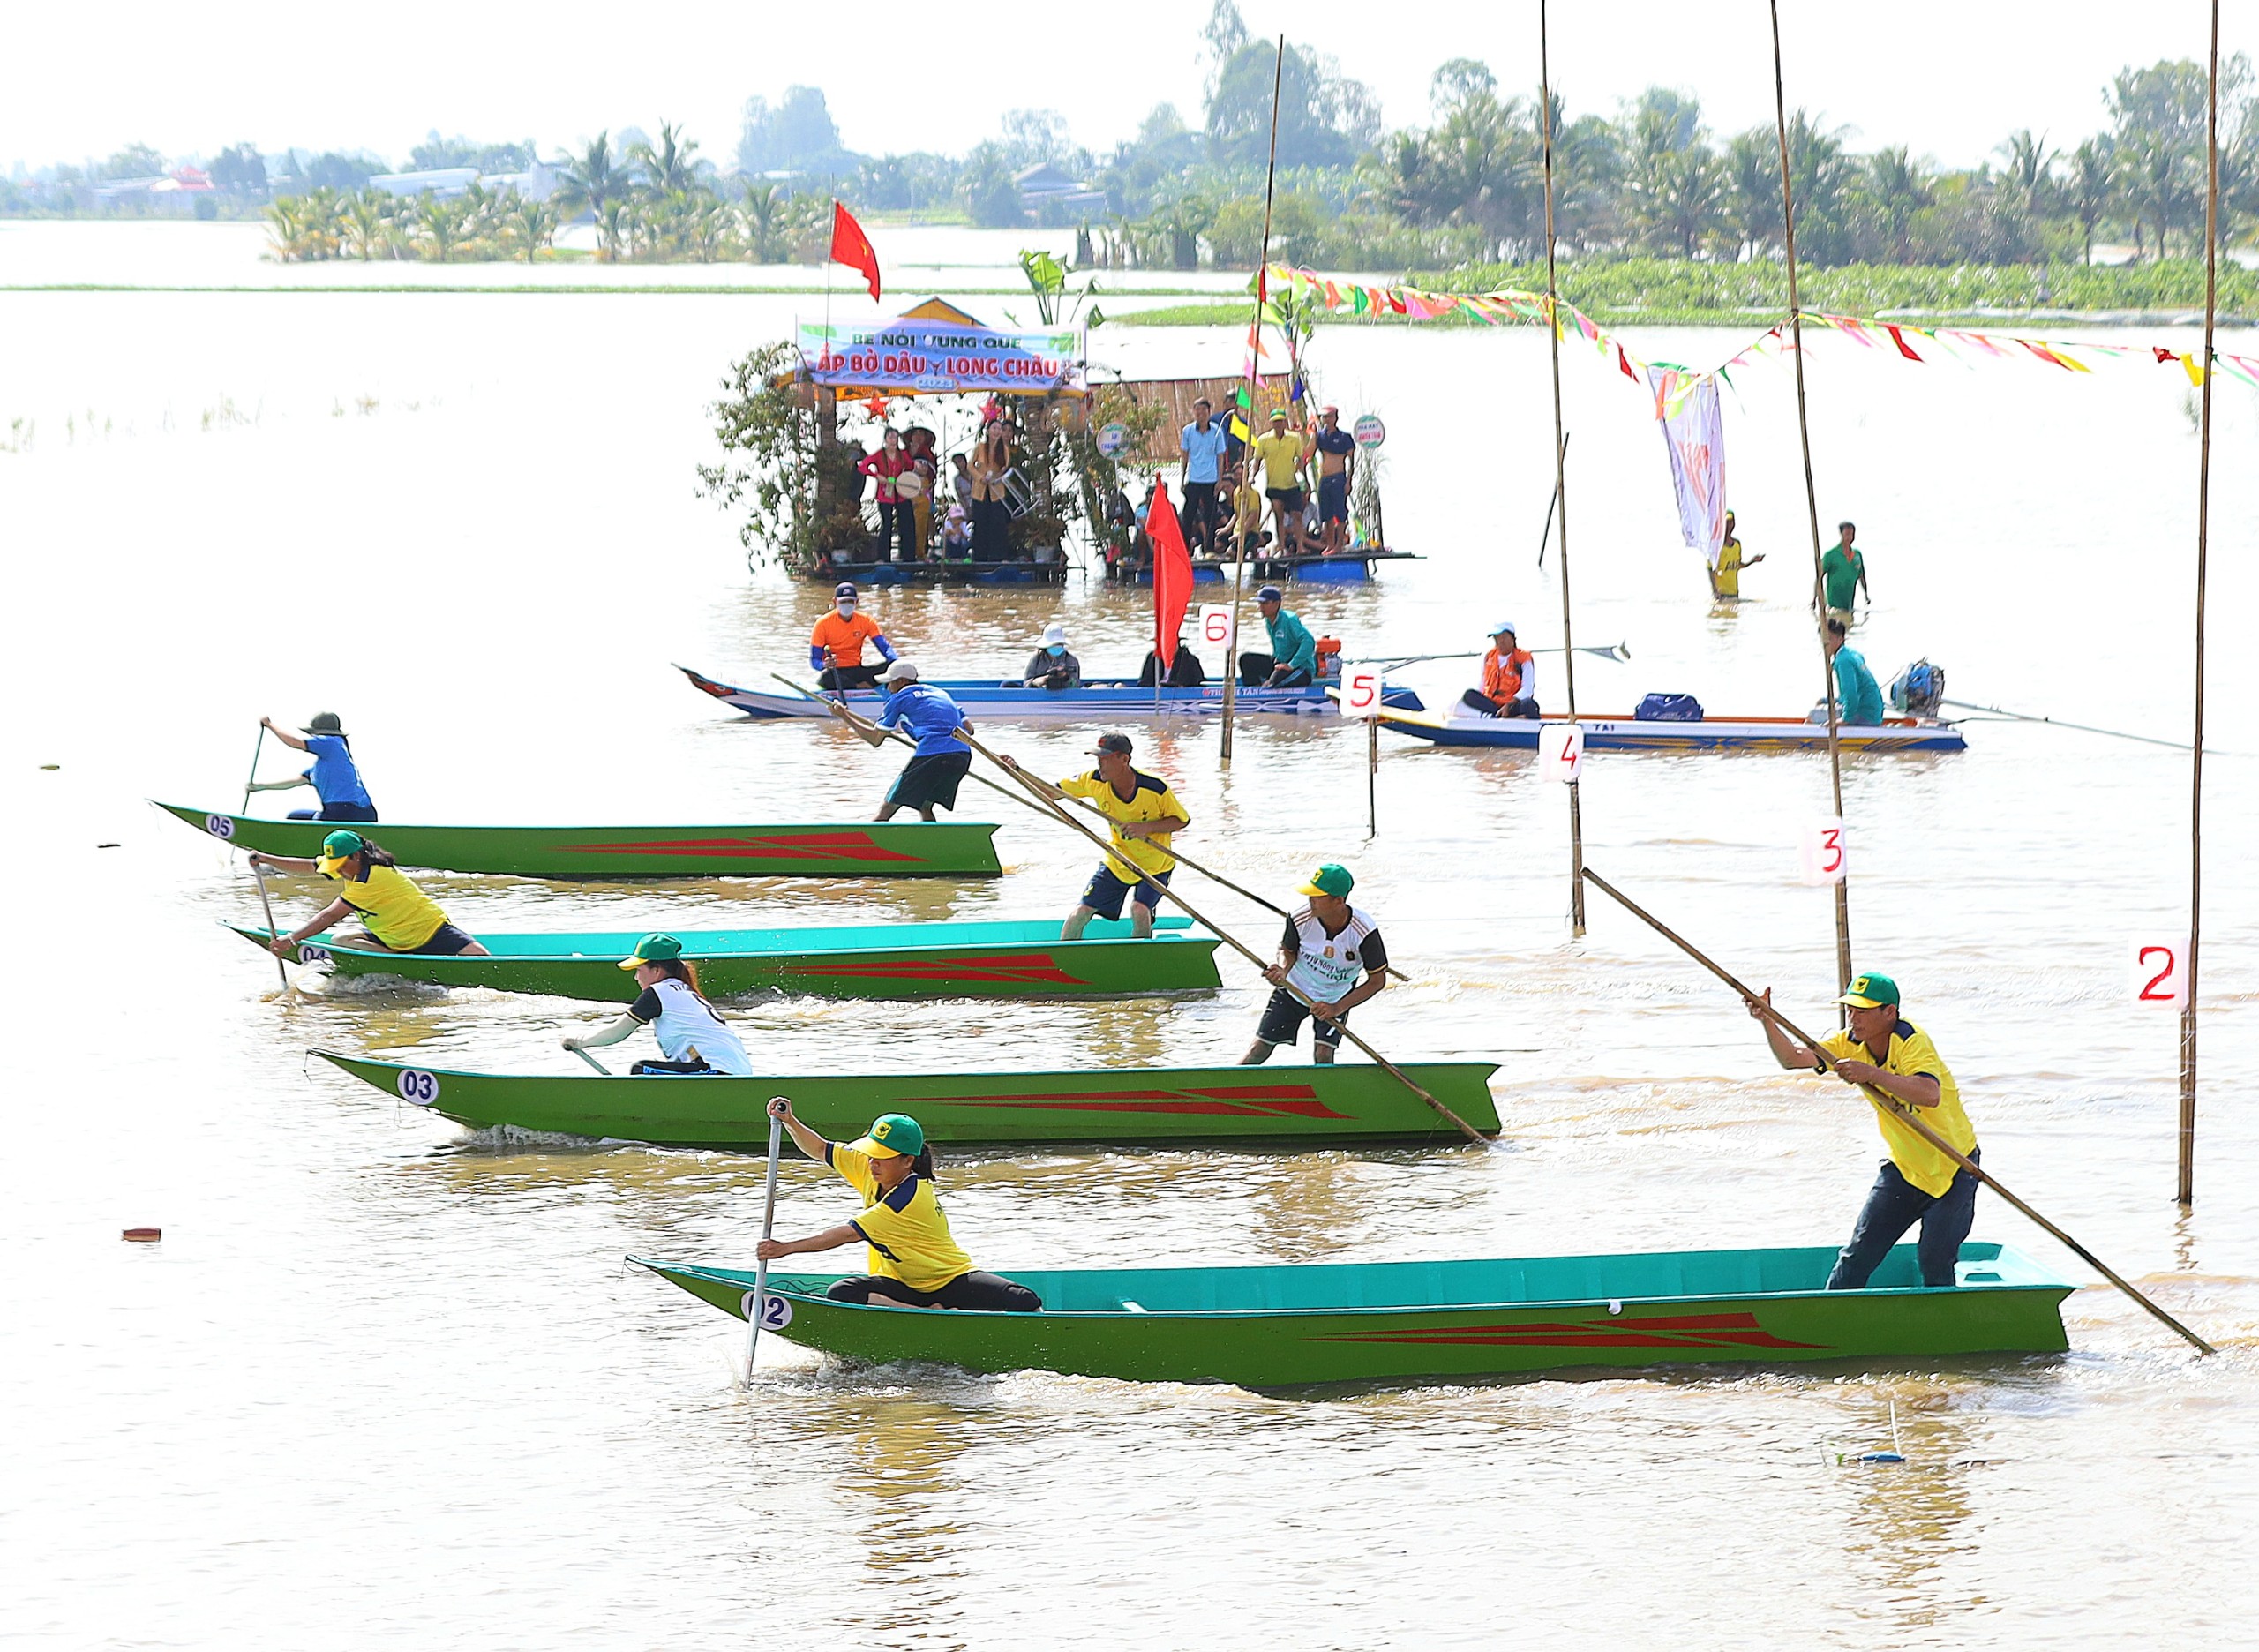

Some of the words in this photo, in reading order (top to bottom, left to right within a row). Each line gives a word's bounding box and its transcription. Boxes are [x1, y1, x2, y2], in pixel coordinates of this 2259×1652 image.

[946, 356, 999, 377] LONG
[1205, 612, 1228, 642] 6
[1350, 674, 1375, 708] 5
[1560, 735, 1577, 770] 4
[210, 815, 229, 837] 05
[1820, 828, 1842, 873] 3
[2138, 946, 2175, 1001] 2
[403, 1070, 432, 1100] 03
